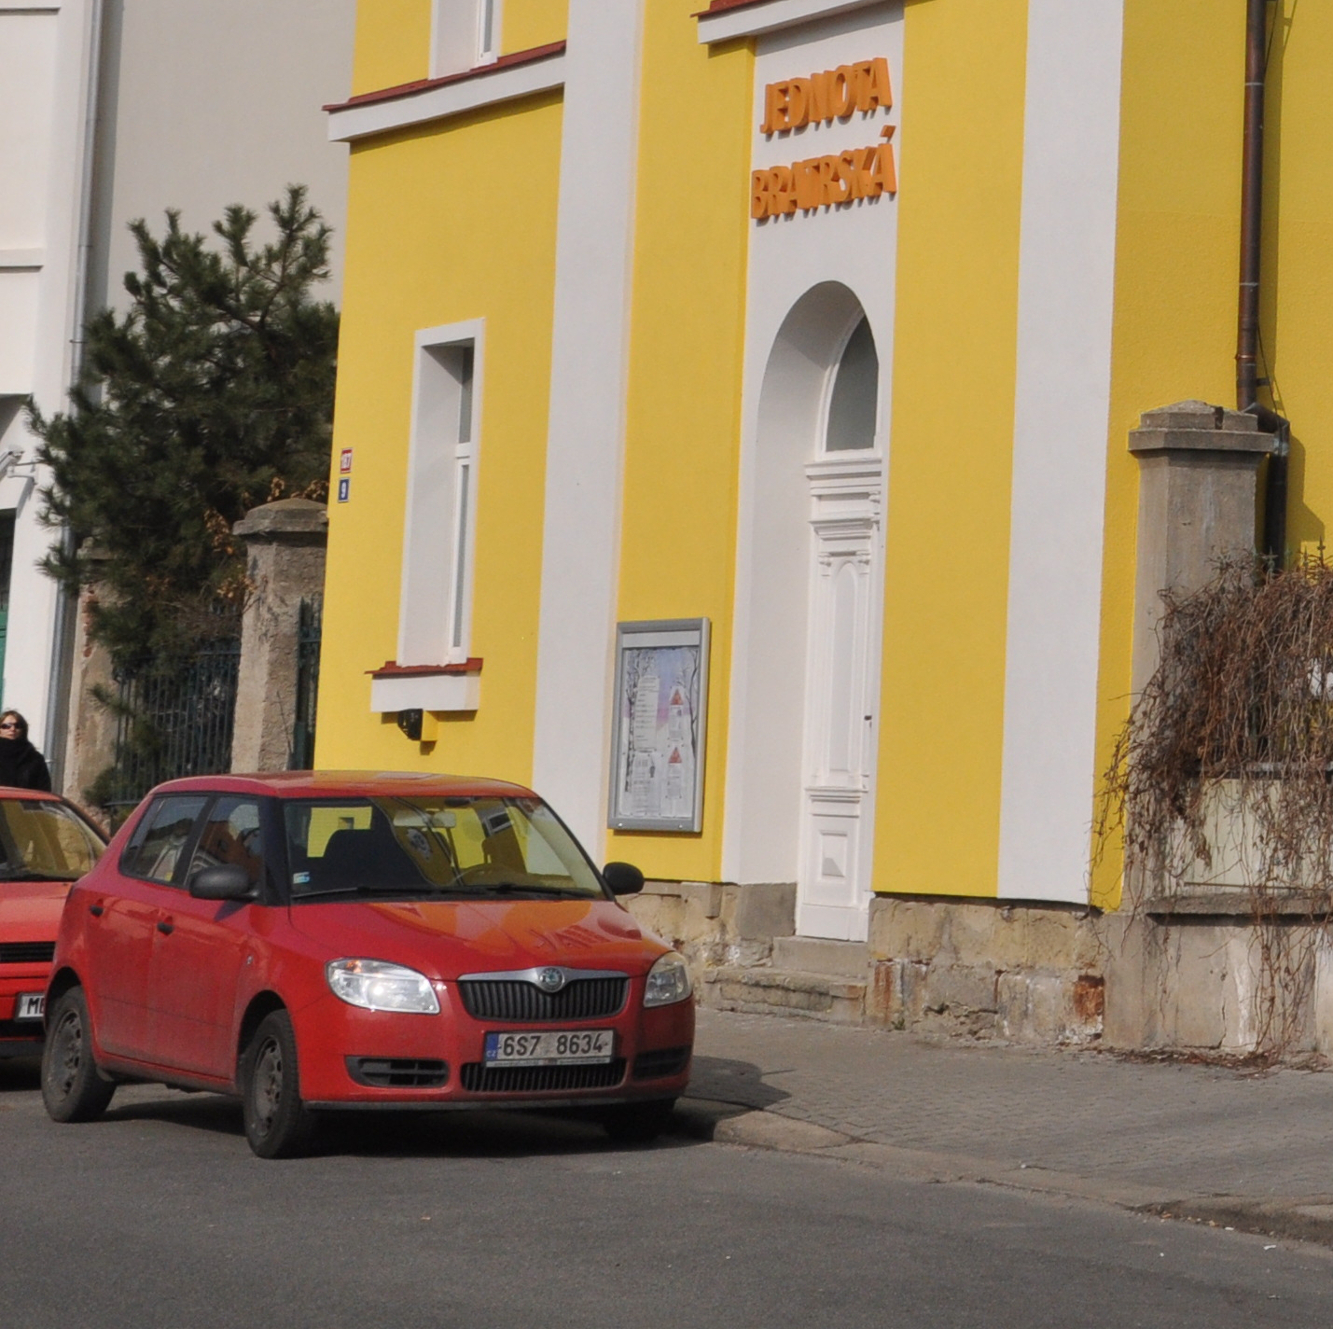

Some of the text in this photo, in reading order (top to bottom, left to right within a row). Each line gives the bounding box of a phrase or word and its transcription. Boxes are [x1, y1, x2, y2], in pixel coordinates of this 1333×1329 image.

[760, 57, 892, 135] JEDNOTA
[751, 125, 897, 219] BRATRSKÁ
[503, 1033, 603, 1056] 6S7 8634
